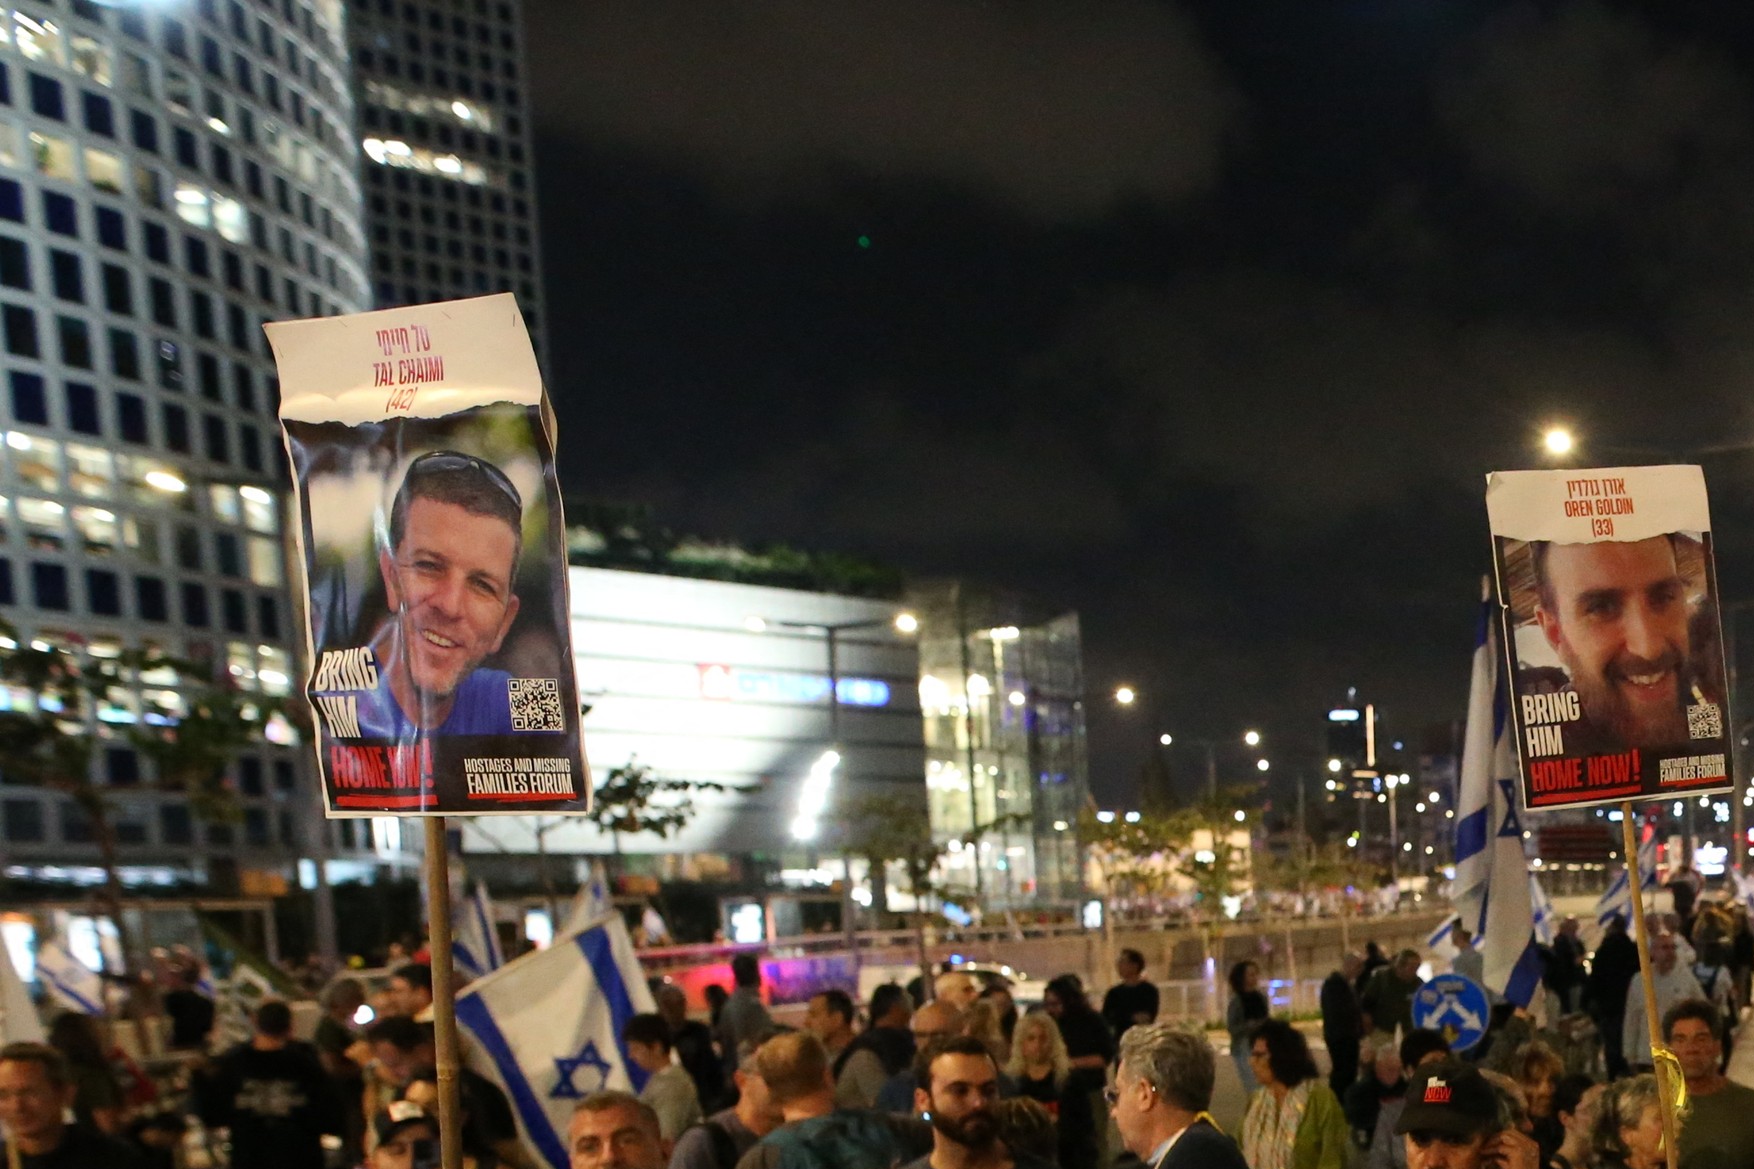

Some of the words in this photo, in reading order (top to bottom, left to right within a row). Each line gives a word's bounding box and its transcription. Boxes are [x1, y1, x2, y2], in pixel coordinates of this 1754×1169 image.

[411, 323, 431, 353] טל
[373, 361, 395, 387] TAL
[398, 356, 444, 385] CHAIMI
[385, 387, 418, 413] (42)
[1566, 479, 1600, 499] גולדין
[1602, 478, 1626, 497] אורן
[1564, 500, 1594, 517] OREN
[1595, 498, 1634, 515] GOLDIN
[1591, 518, 1614, 538] (33)
[315, 646, 379, 692] BRING
[316, 695, 362, 738] HIM
[1521, 691, 1580, 726] BRING
[1525, 725, 1564, 758] HIM
[330, 746, 390, 788] HOME
[464, 758, 513, 773] HOSTAGES
[514, 758, 532, 772] AND
[533, 758, 571, 773] MISSING
[1530, 758, 1583, 792] HOME
[1586, 748, 1641, 786] NOW!
[1660, 766, 1696, 783] FAMILIES
[1697, 763, 1726, 780] FORUM
[466, 773, 529, 795] FAMILIES
[530, 773, 575, 795] FORUM
